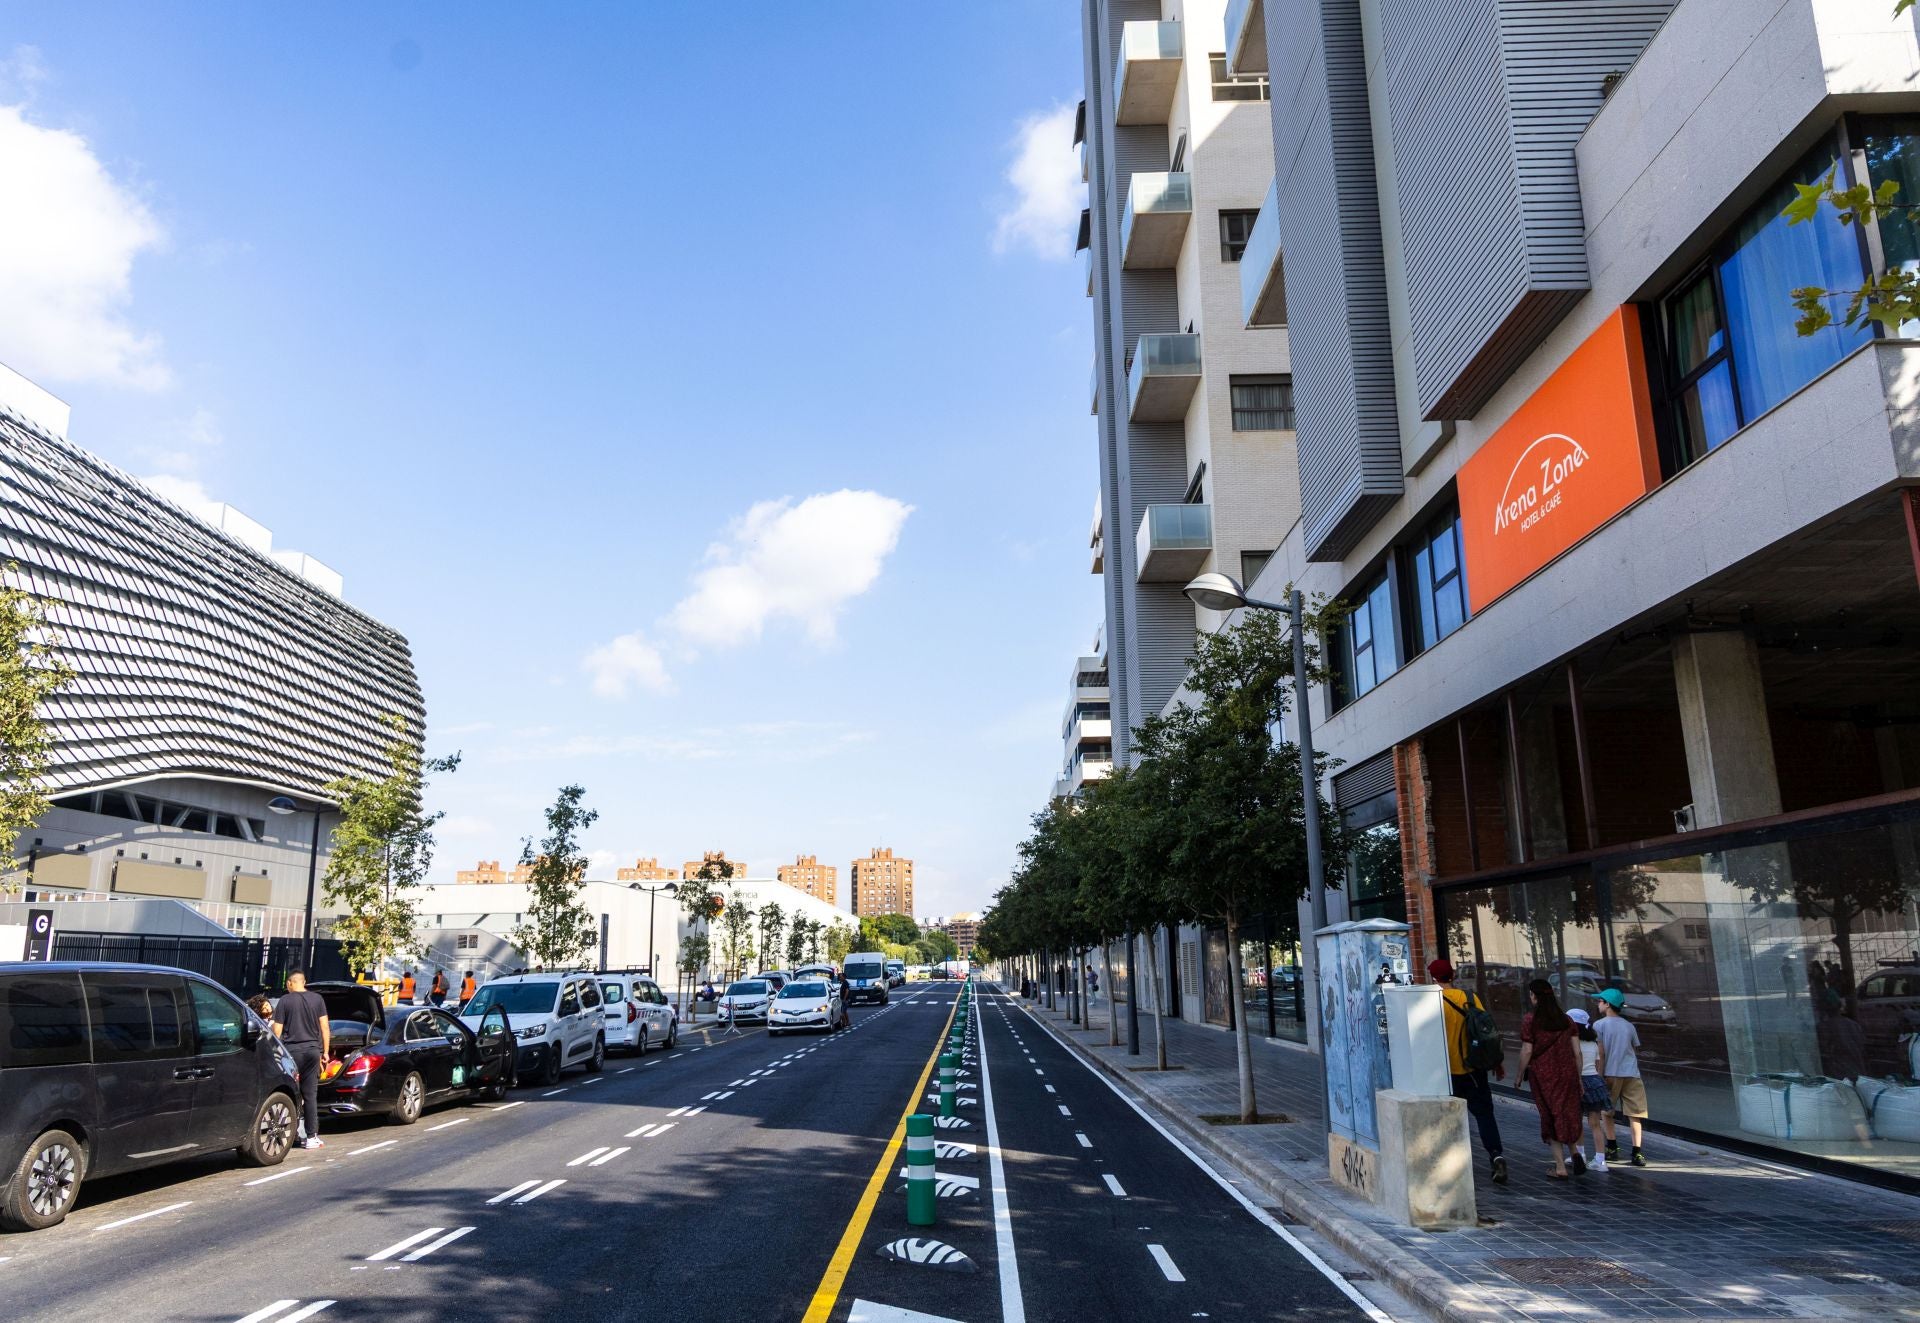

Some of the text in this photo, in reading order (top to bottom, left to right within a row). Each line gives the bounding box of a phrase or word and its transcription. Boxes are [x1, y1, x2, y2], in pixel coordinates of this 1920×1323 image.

[1495, 447, 1584, 535] Arena Zone
[1521, 489, 1562, 533] HOTEL & CAFÉ
[35, 914, 49, 933] G
